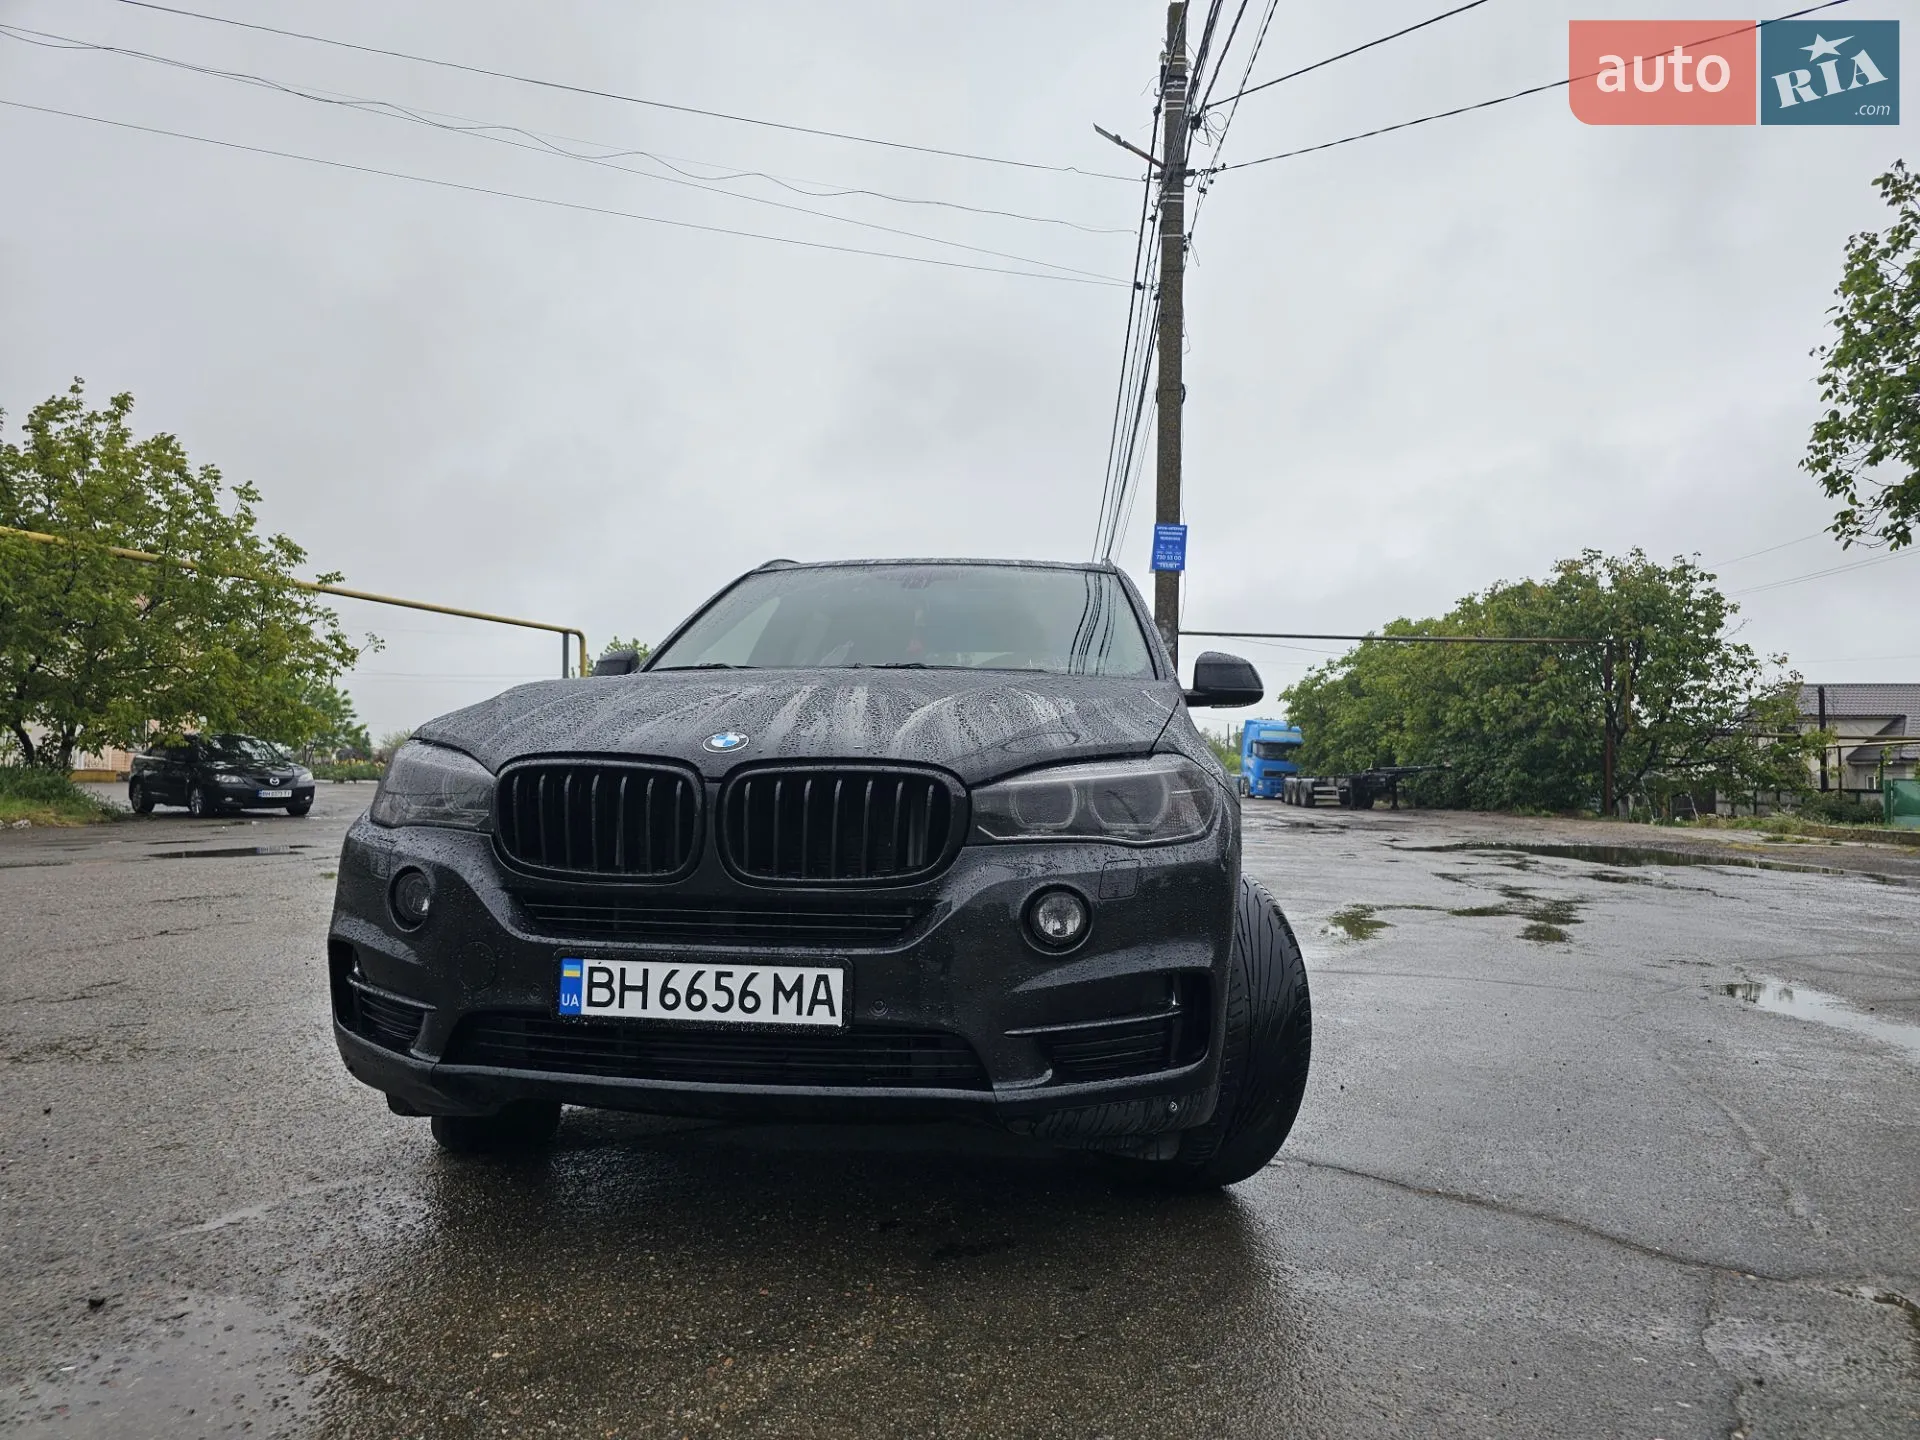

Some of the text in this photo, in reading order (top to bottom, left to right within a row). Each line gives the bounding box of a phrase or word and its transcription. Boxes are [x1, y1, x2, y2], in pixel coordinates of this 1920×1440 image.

[561, 993, 579, 1007] UA
[586, 966, 836, 1017] BH 6656 MA
